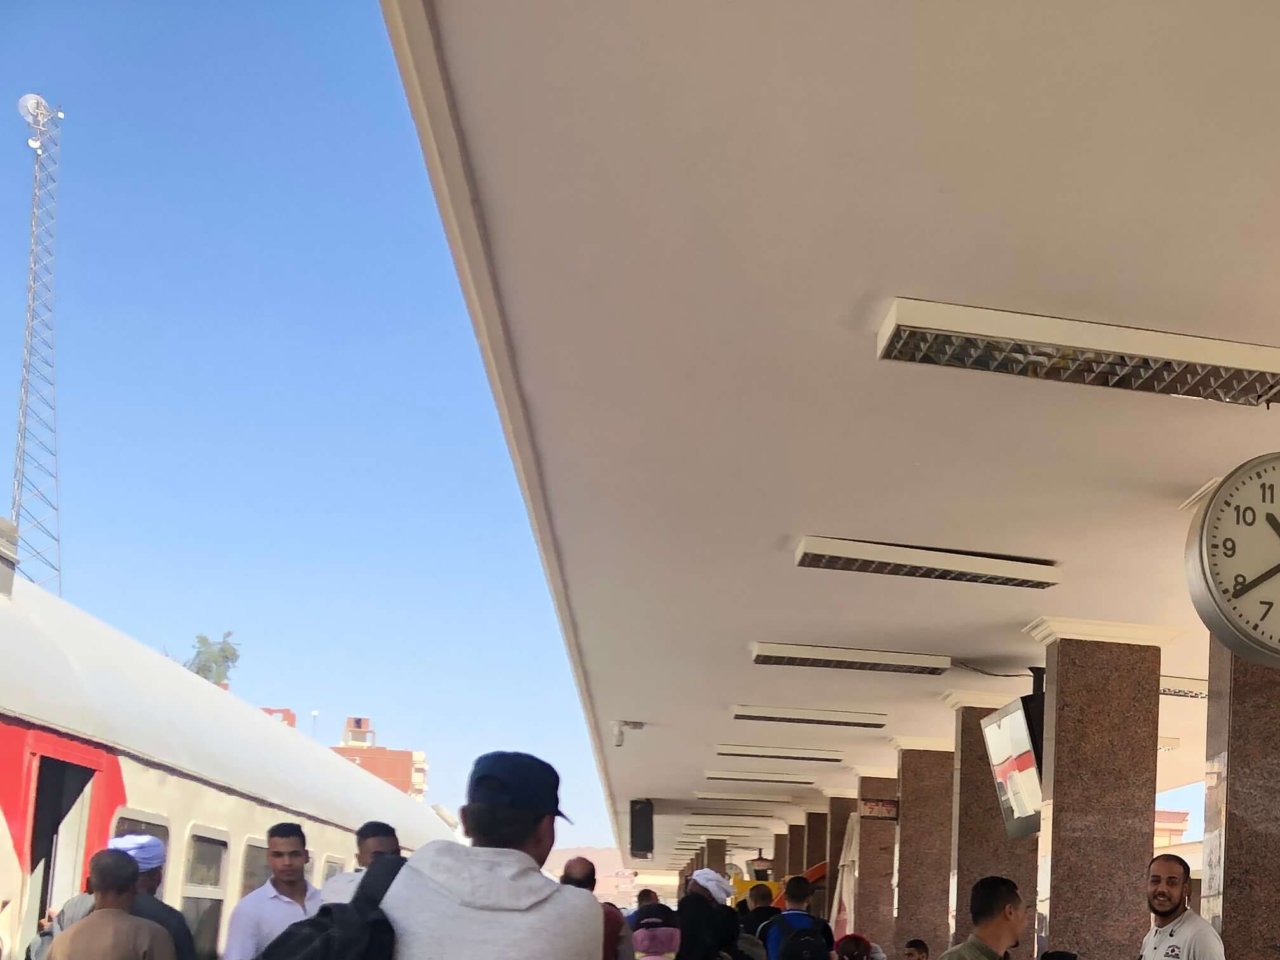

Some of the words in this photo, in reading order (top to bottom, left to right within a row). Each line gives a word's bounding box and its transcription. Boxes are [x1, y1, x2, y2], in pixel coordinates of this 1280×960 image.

[1260, 483, 1274, 503] 11
[1234, 505, 1256, 526] 10
[1222, 538, 1235, 558] 9
[1259, 601, 1273, 621] 7
